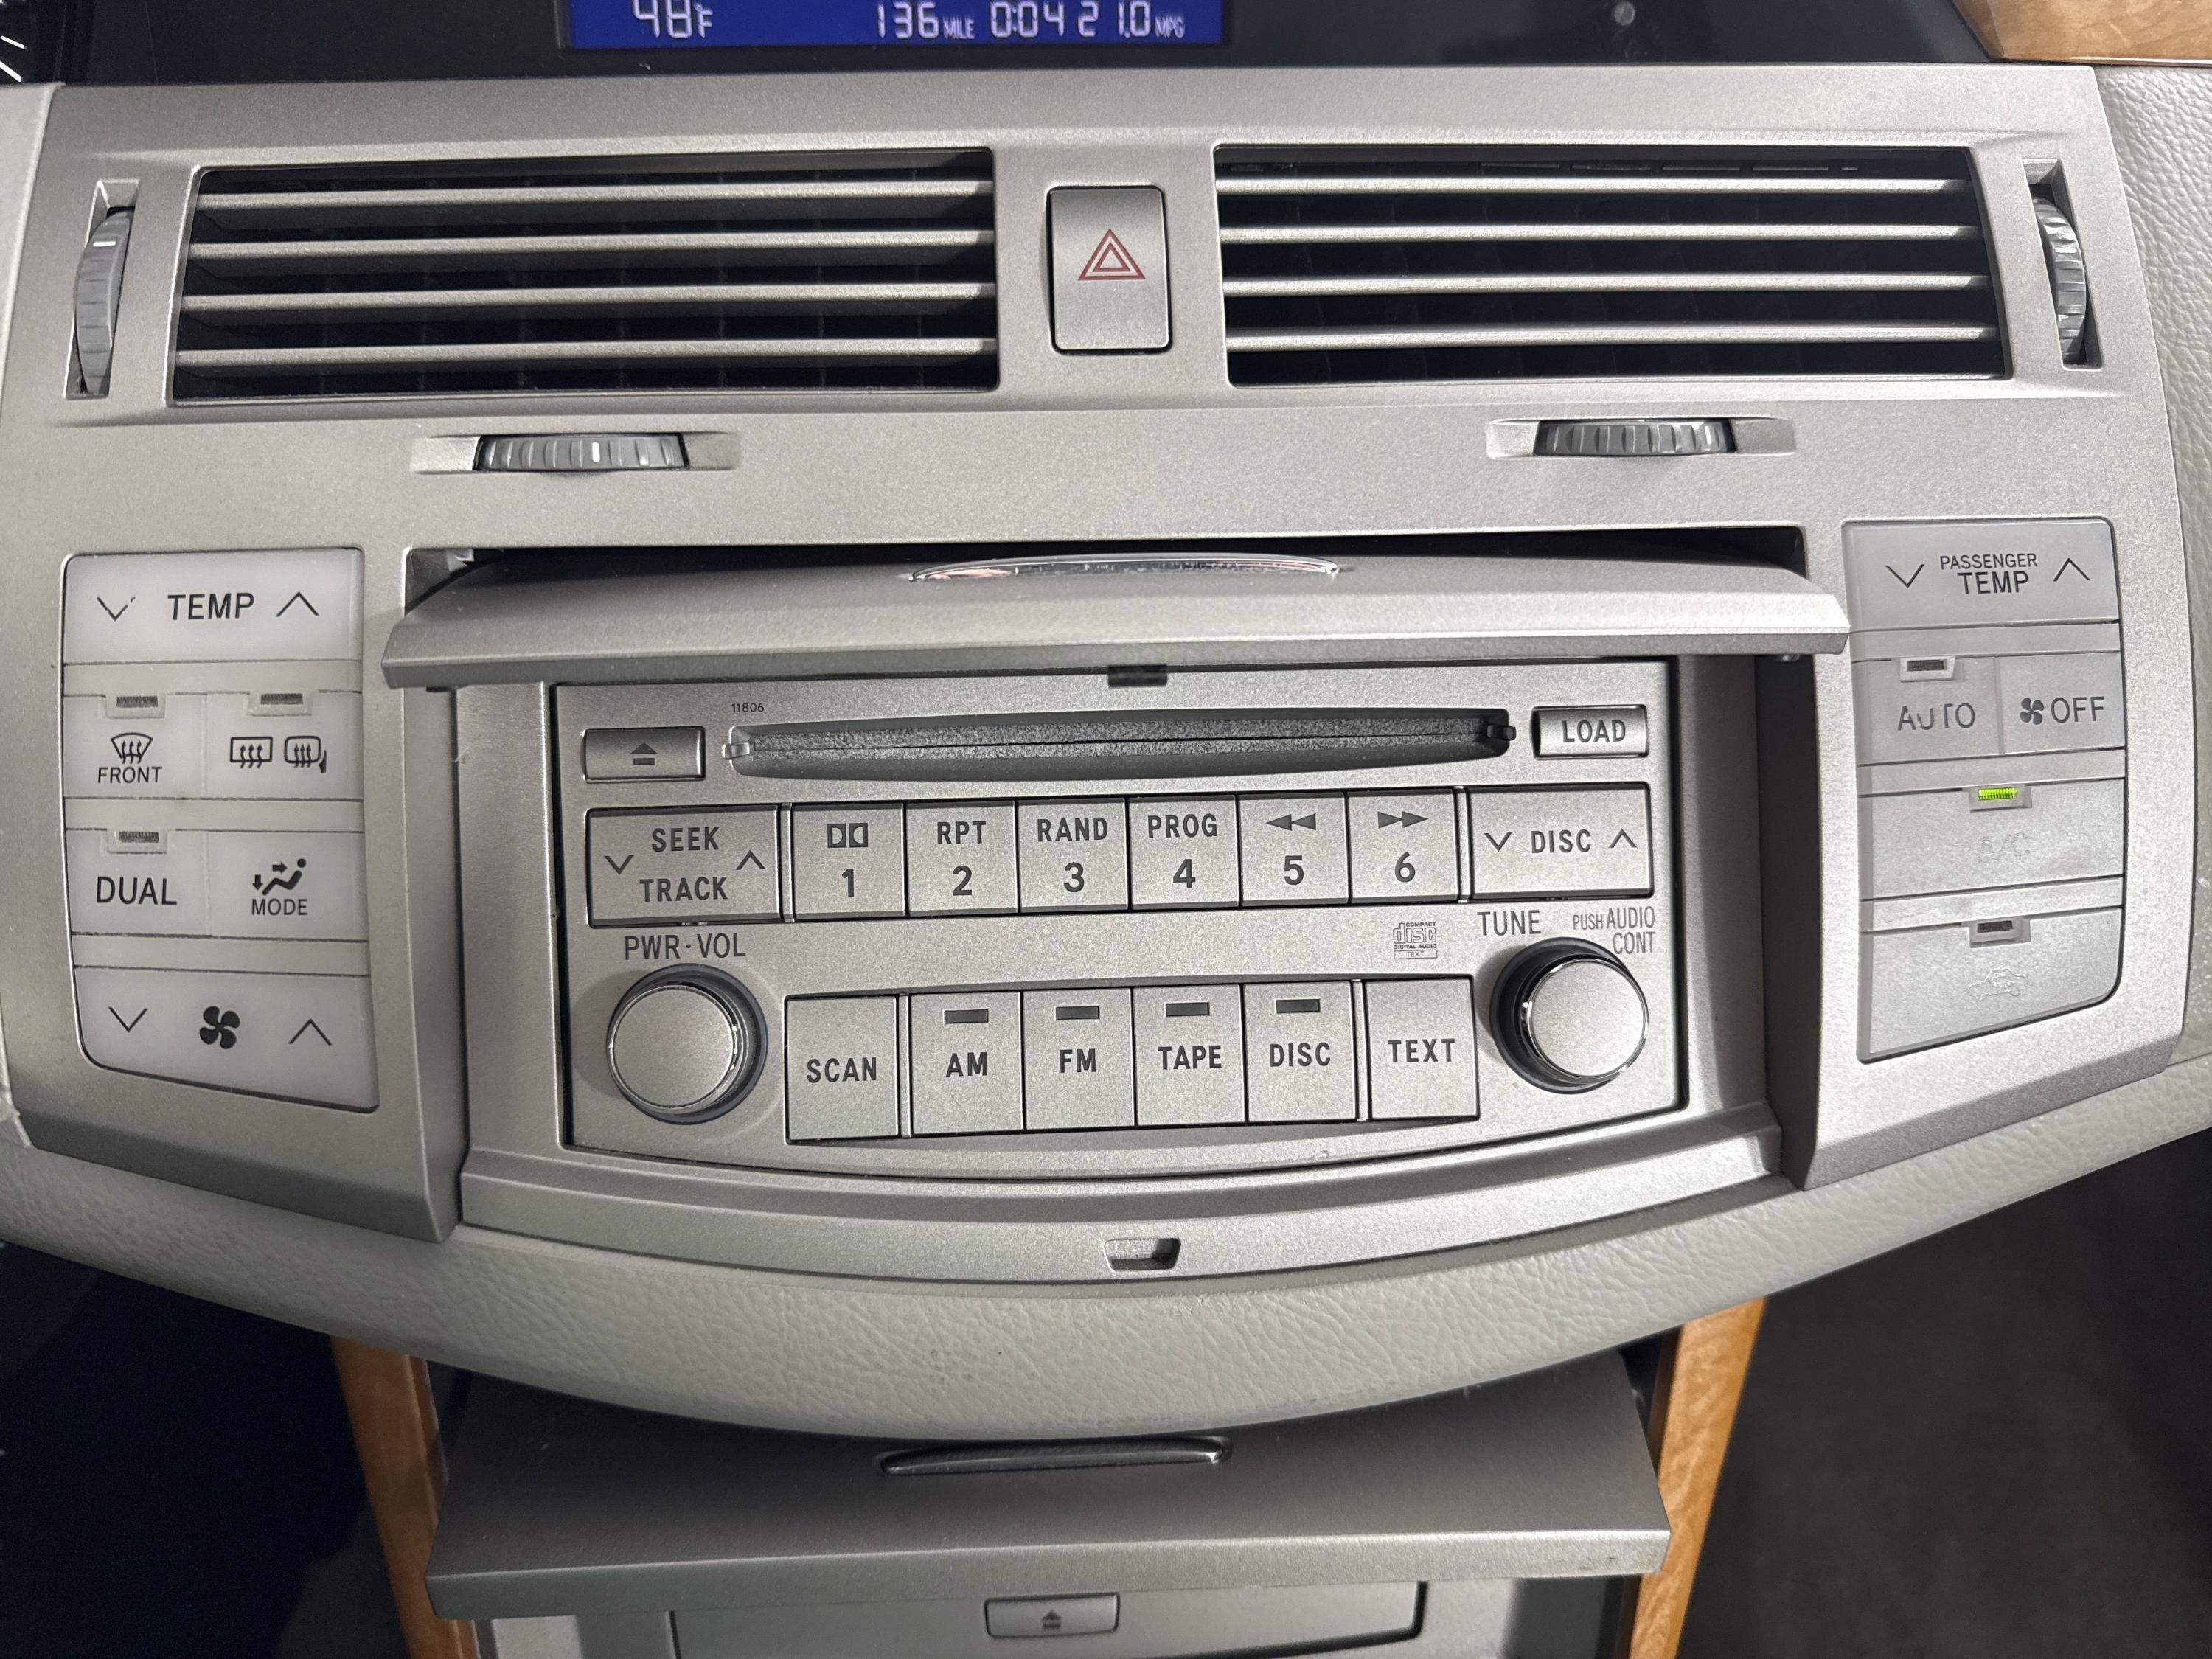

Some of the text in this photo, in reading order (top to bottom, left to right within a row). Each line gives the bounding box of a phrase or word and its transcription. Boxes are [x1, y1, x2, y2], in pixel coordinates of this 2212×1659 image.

[943, 16, 975, 40] MILE
[1155, 15, 1185, 38] MPG
[1940, 553, 2038, 570] PASSENGER
[1957, 571, 2029, 594] TEMP
[167, 592, 254, 621] TEMP
[731, 703, 765, 713] 11806
[1897, 703, 1976, 731] AUTO
[2051, 695, 2105, 723] OFF
[1562, 720, 1627, 743] LOAD
[97, 766, 163, 784] FRONT
[937, 821, 987, 845] RPT
[1037, 817, 1107, 842] RAND
[1148, 813, 1218, 838] PROG
[651, 827, 720, 852] SEEK
[1531, 829, 1592, 854] DISC
[1063, 861, 1085, 893] 3
[1173, 858, 1196, 888] 4
[1284, 855, 1304, 886] 5
[1394, 852, 1416, 883] 6
[96, 876, 178, 905] DUAL
[639, 877, 728, 902] TRACK
[841, 868, 855, 898] 1
[952, 865, 973, 896] 2
[251, 898, 308, 916] MODE
[1573, 906, 1655, 930] PUSH AUDIO
[1477, 910, 1542, 936] TUNE
[1613, 931, 1656, 955] CONT
[1060, 1048, 1097, 1073] FM
[1158, 1045, 1222, 1070] TAPE
[1269, 1042, 1332, 1068] DISC
[1387, 1038, 1455, 1063] TEXT
[807, 1057, 877, 1083] SCAN
[945, 1051, 988, 1077] AM
